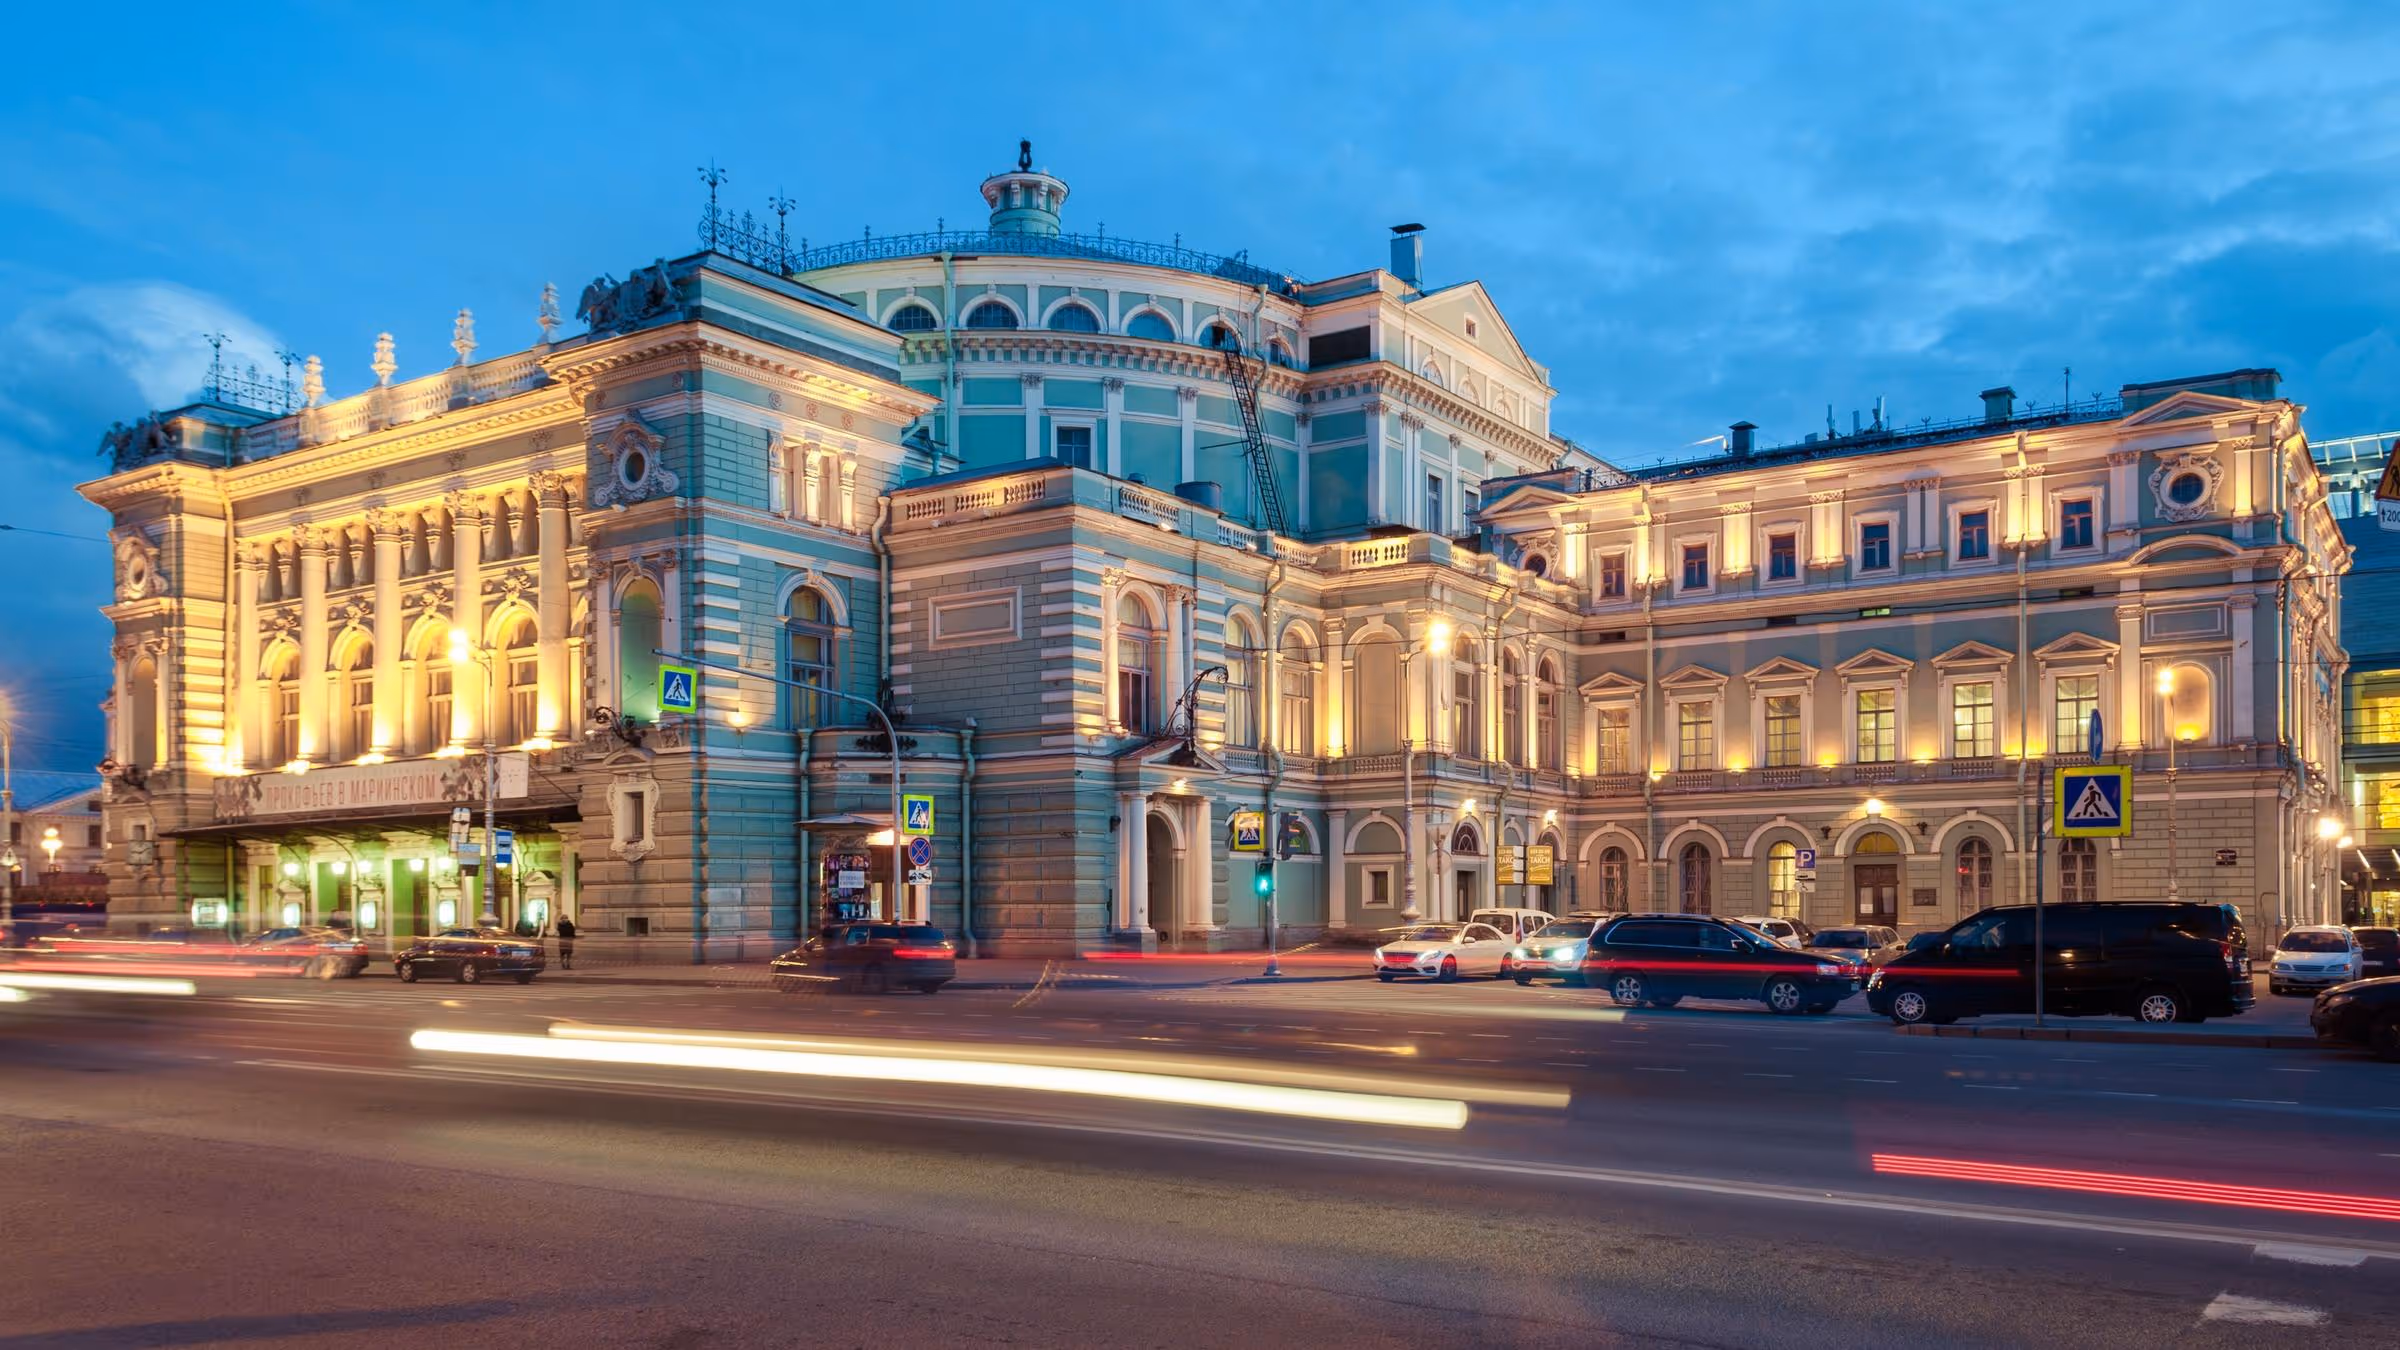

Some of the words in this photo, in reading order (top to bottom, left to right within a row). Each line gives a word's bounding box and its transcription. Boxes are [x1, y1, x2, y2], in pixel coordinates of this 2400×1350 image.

[266, 781, 333, 809] ПРОКОФЬЕВ
[338, 780, 345, 804] В
[350, 775, 435, 803] МАРИИНСКОМ
[1529, 856, 1550, 864] ТАКСИ
